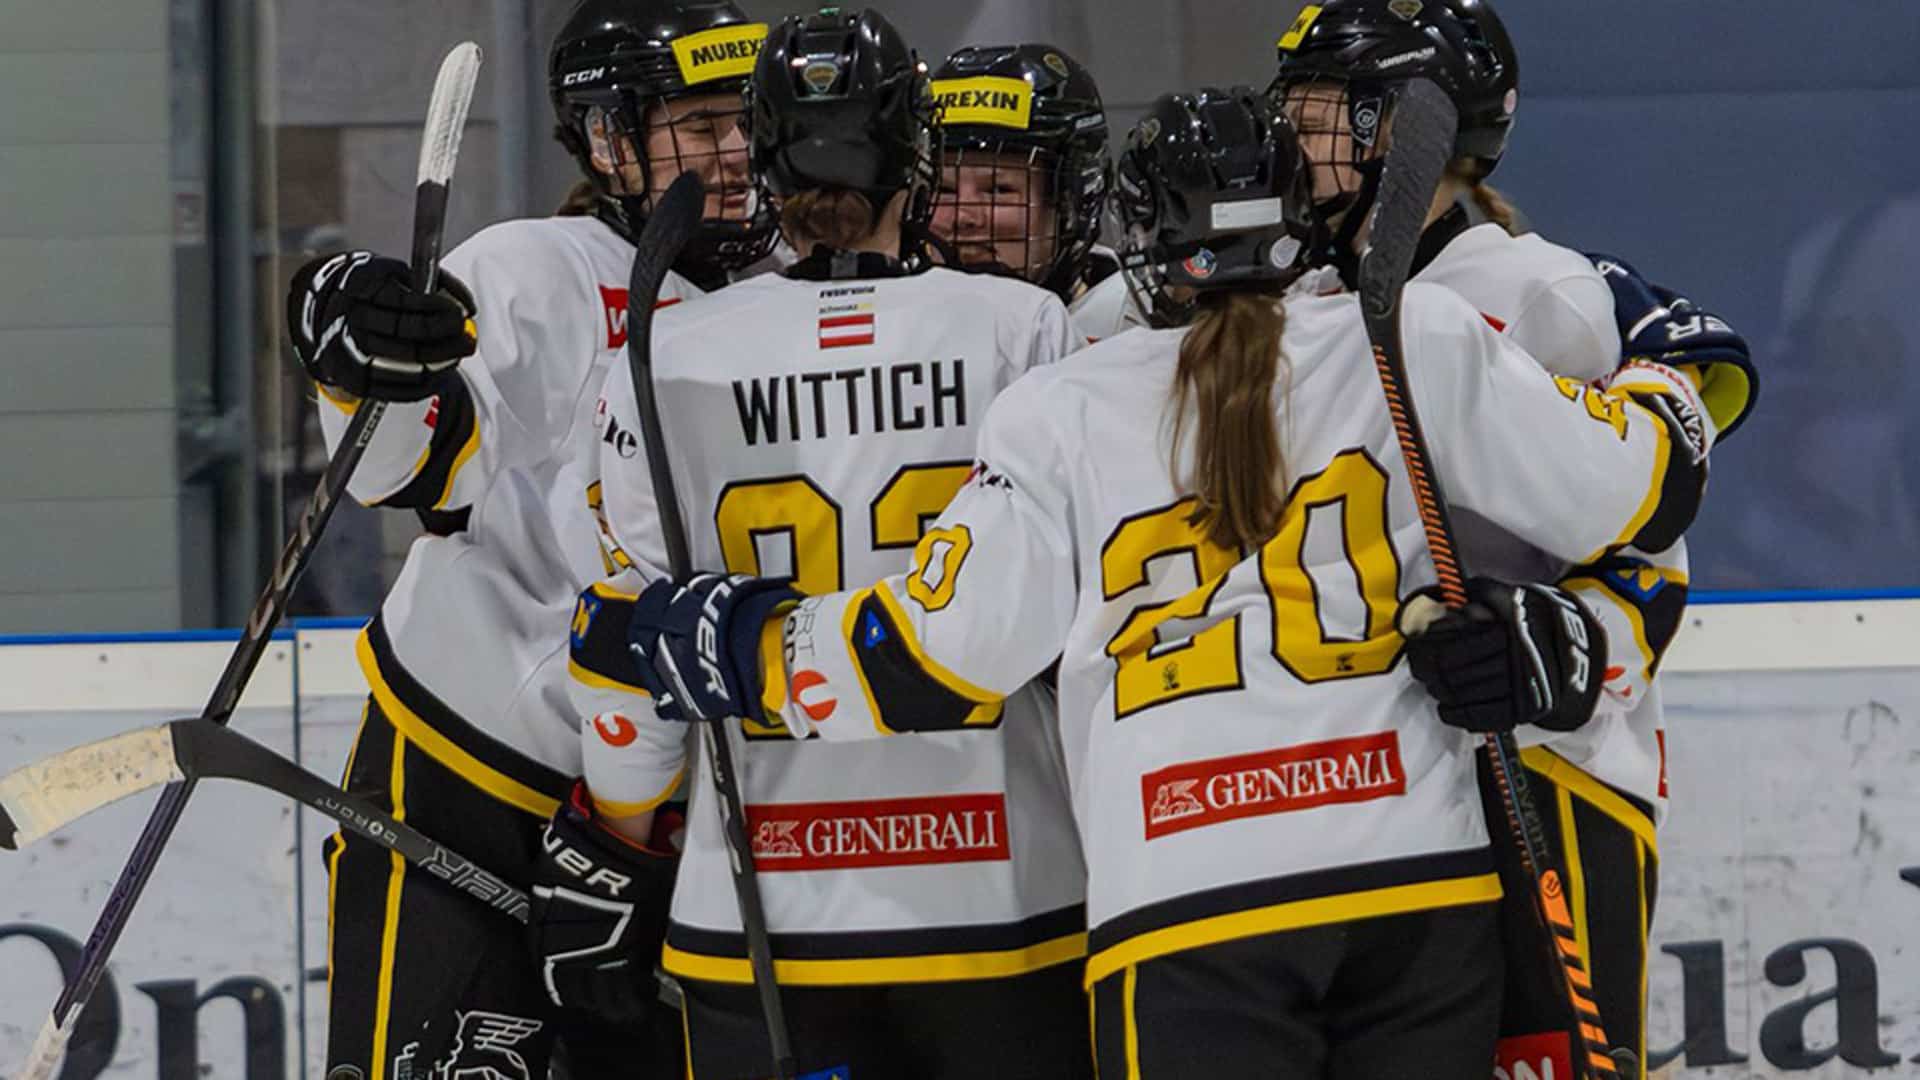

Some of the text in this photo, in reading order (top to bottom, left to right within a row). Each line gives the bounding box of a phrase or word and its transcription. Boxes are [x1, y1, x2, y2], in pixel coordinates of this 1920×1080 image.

[563, 66, 605, 86] CCM
[690, 39, 765, 67] MUREX
[933, 88, 1029, 112] REXIN
[732, 358, 968, 446] WITTICH
[1101, 446, 1405, 720] 20
[1205, 748, 1398, 810] GENERALI
[805, 810, 1000, 858] GENERALI
